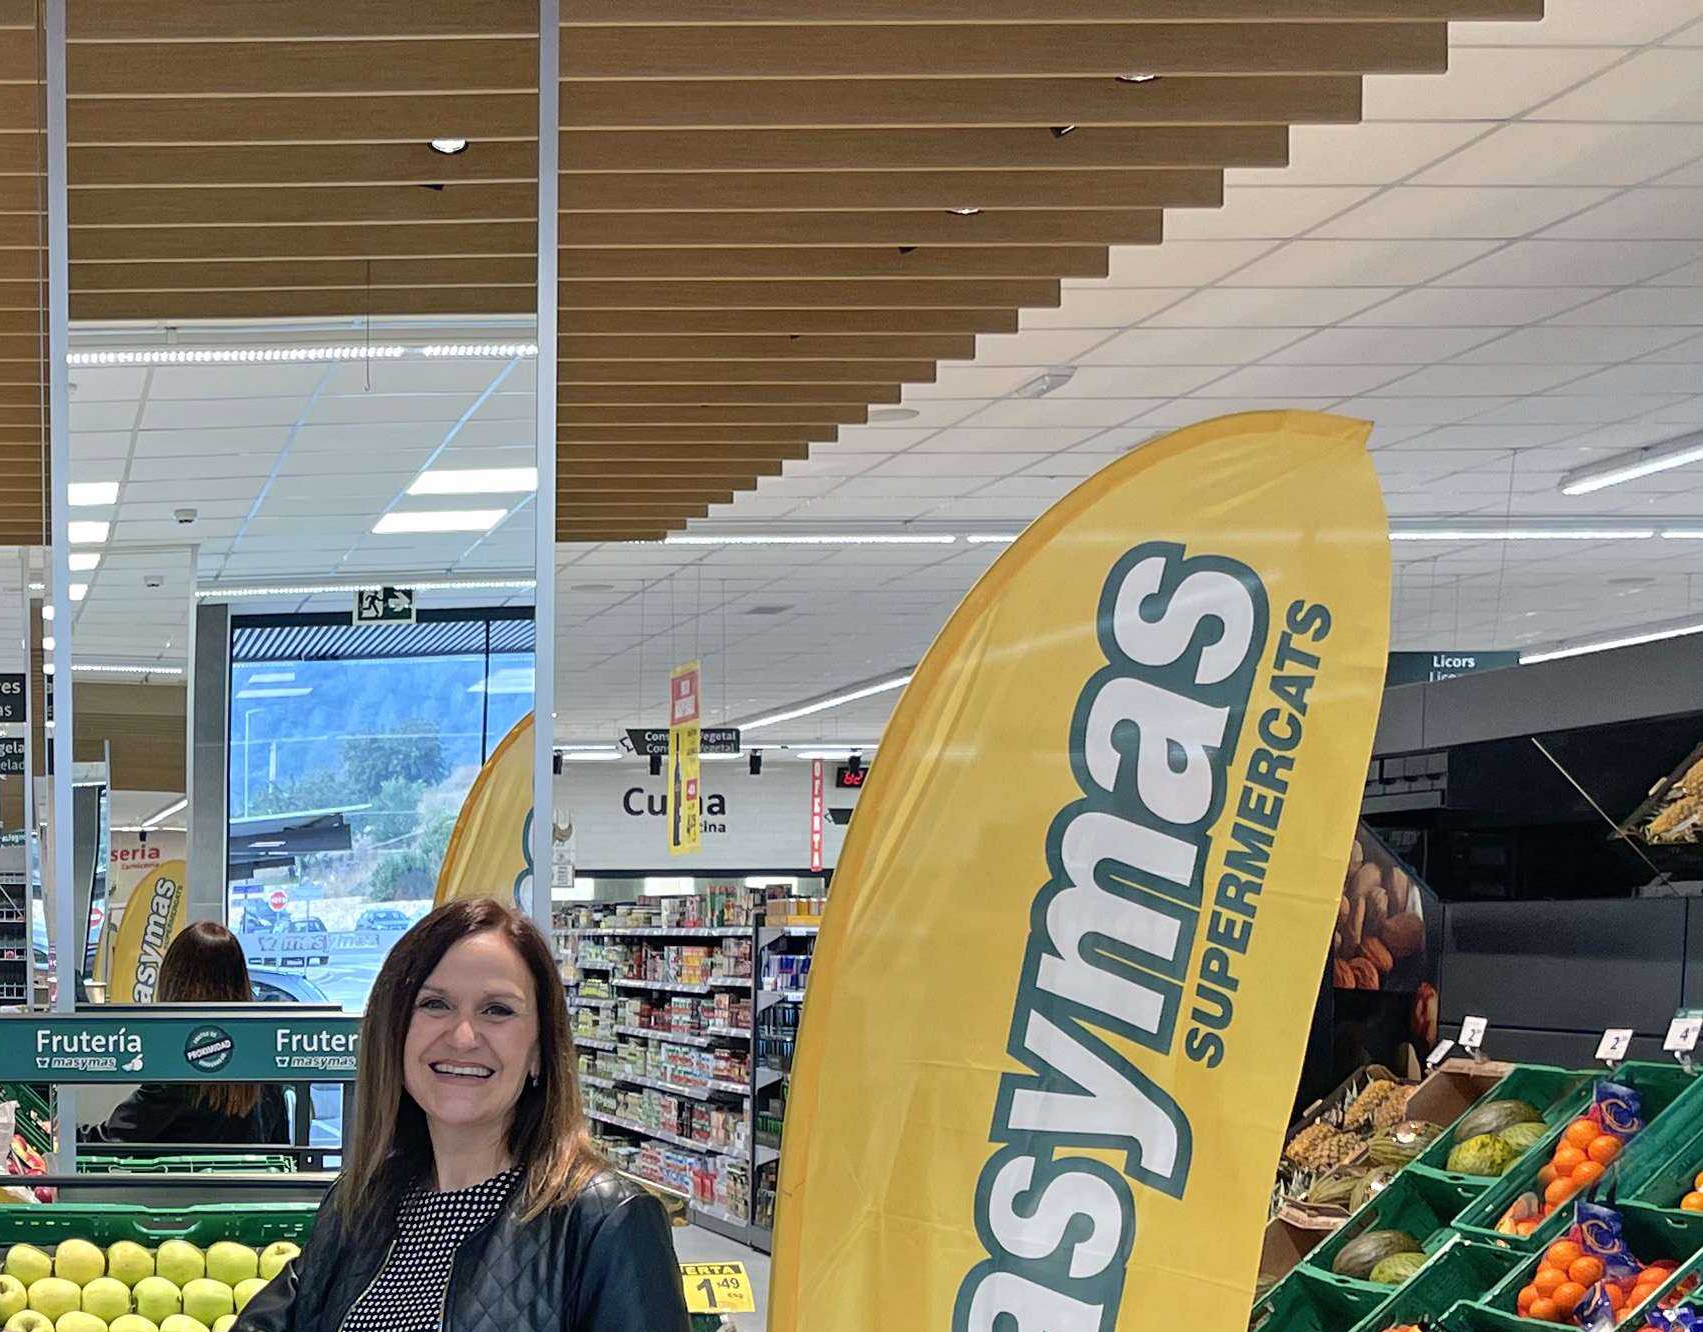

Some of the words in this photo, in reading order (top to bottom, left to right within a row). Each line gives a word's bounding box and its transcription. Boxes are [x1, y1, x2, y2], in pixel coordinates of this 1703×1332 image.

[1433, 655, 1475, 668] Licors
[1185, 598, 1332, 1068] SUPERMERCATS
[133, 877, 175, 1003] asymas
[36, 1028, 142, 1052] Frutería
[276, 1028, 359, 1052] Fruter
[51, 1056, 116, 1070] masymas
[292, 1056, 357, 1070] masymas
[685, 1265, 735, 1275] ERTA
